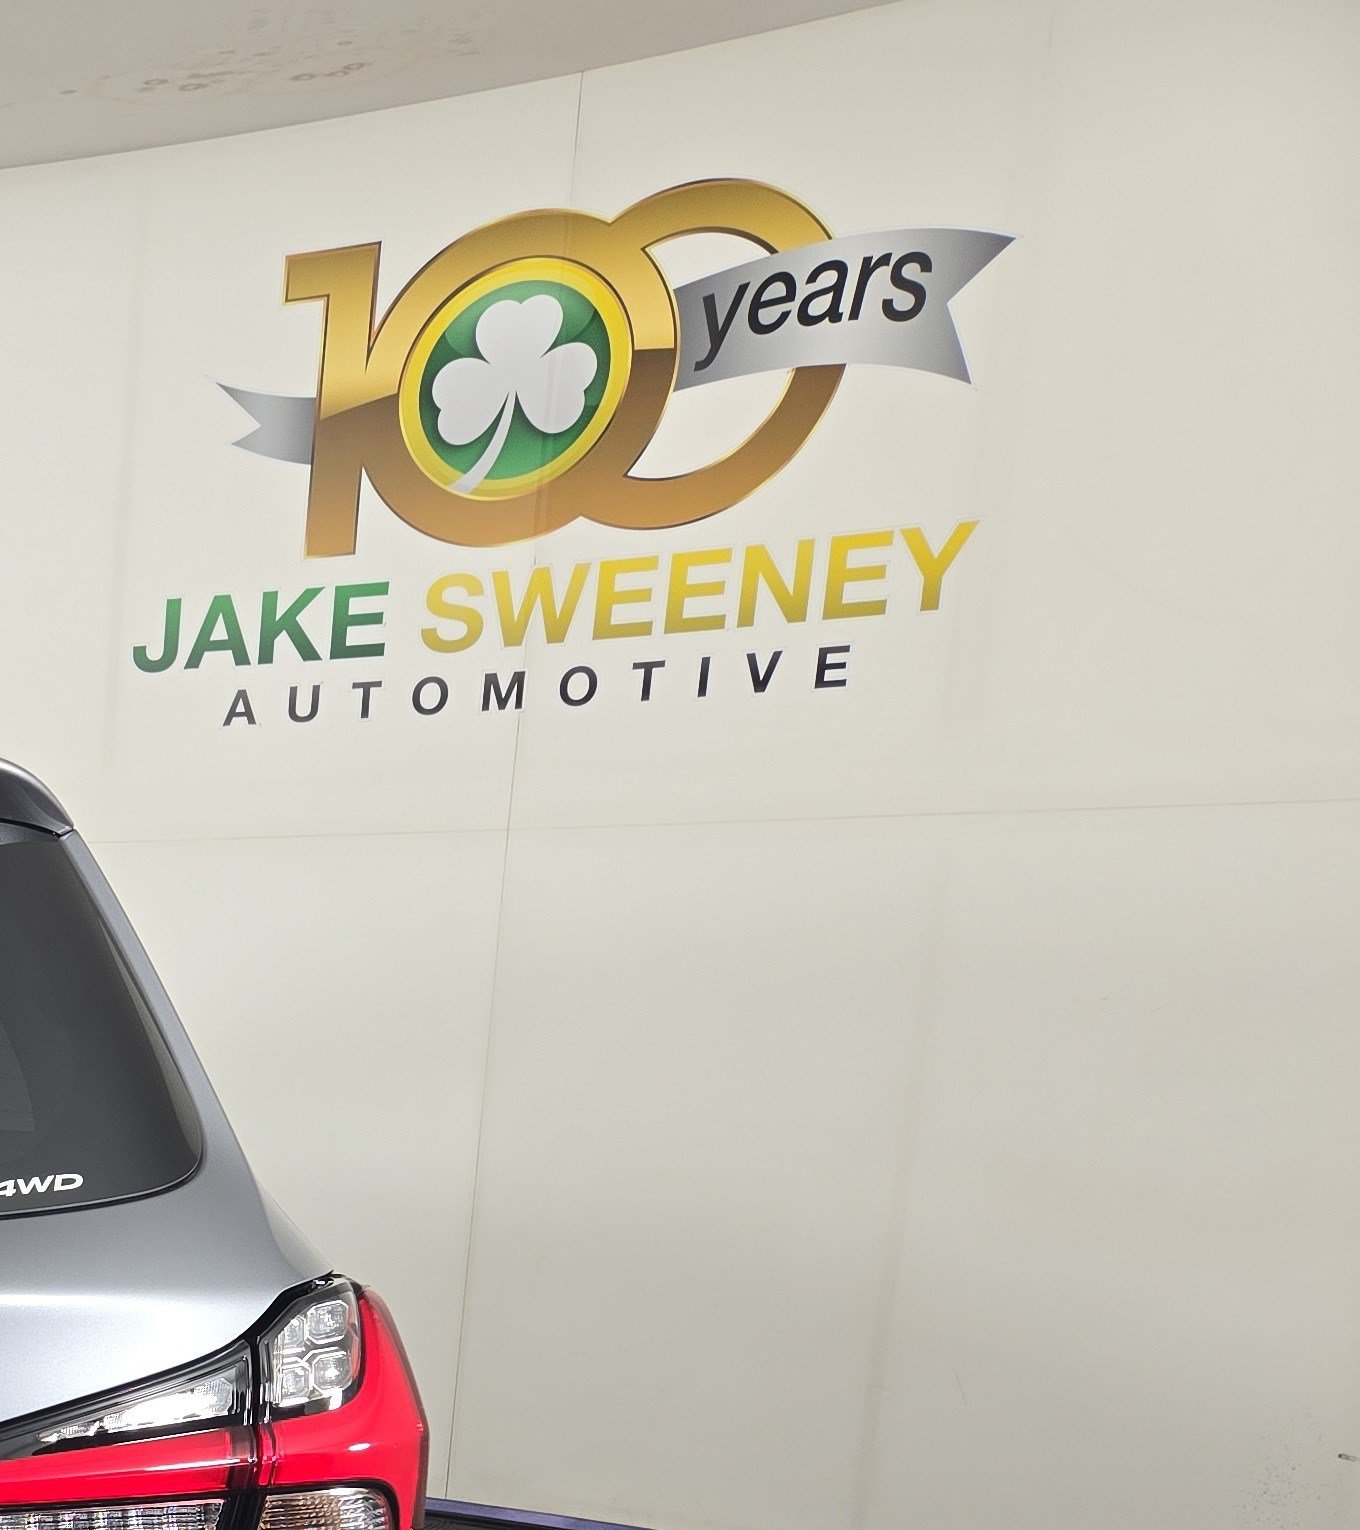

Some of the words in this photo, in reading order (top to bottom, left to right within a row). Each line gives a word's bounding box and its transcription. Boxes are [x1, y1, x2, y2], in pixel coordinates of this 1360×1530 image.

[282, 177, 848, 558] 100
[692, 248, 934, 372] years
[131, 581, 392, 674] JAKE
[420, 519, 980, 654] SWEENEY
[222, 644, 853, 727] AUTOMOTIVE
